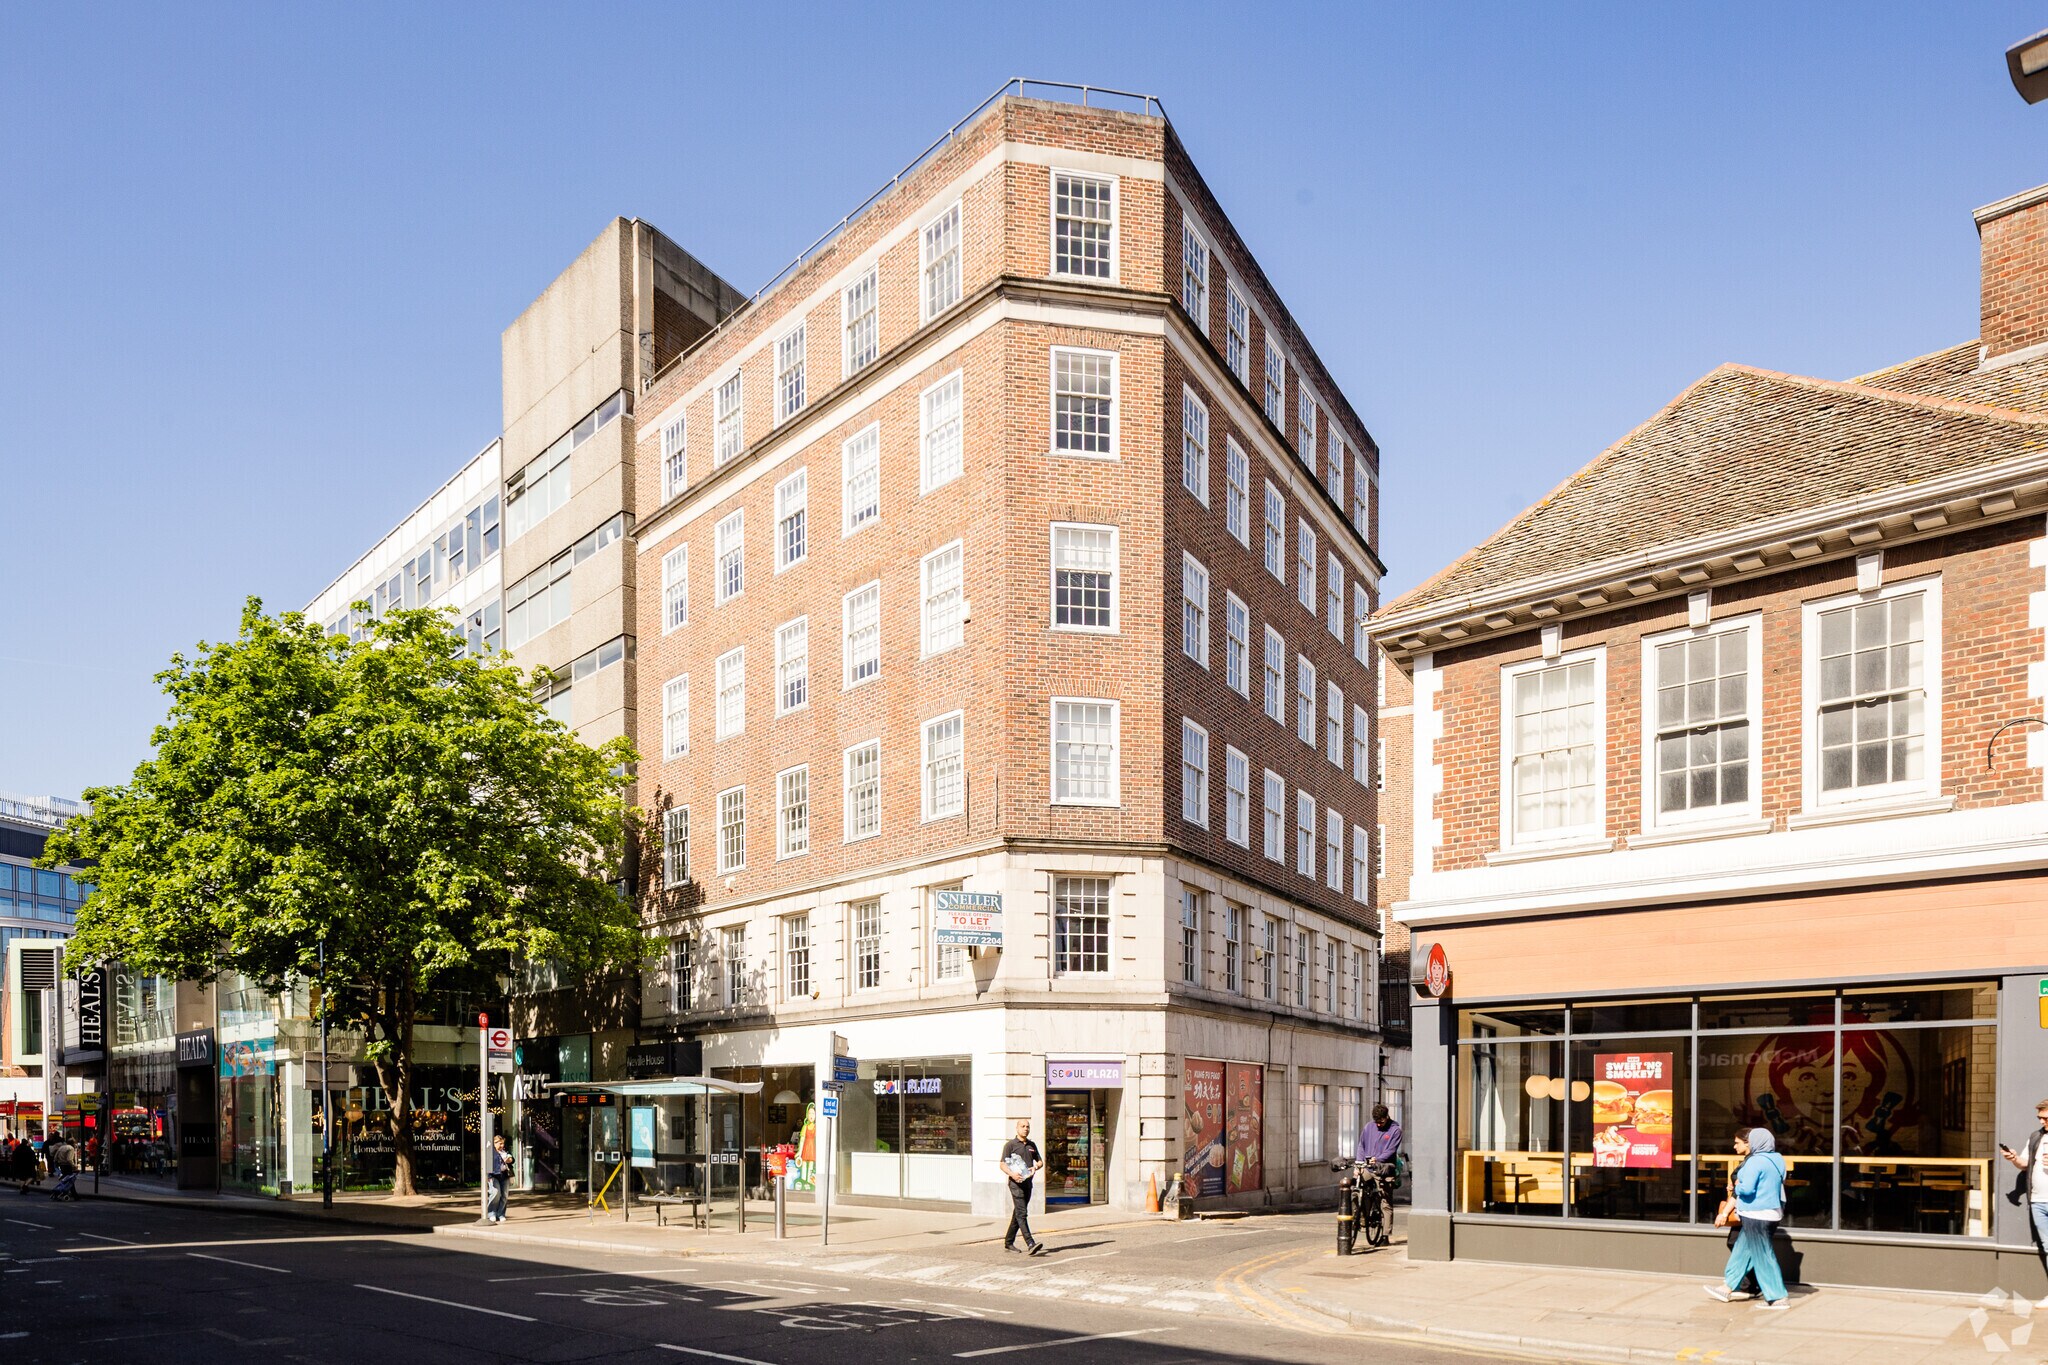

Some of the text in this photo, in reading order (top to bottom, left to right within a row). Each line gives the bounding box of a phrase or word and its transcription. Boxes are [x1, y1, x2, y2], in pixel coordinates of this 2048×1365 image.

[938, 893, 1001, 910] SNELLER
[949, 904, 998, 912] COMMERCIAL
[953, 917, 989, 925] TO LET
[938, 935, 955, 943] 020
[980, 937, 1001, 945] 2204
[81, 972, 101, 1044] HEAL'S
[179, 1034, 208, 1061] HEAL'S
[627, 1055, 664, 1067] Neville House
[1605, 1062, 1642, 1071] SWEET
[560, 1072, 589, 1082] FUSION
[1052, 1069, 1119, 1079] SEOUL PLAZA
[1194, 1070, 1220, 1080] KUNG FU FOOD
[1605, 1070, 1654, 1079] SMOKEY
[513, 1073, 550, 1100] ARTS
[874, 1080, 907, 1095] SEOU
[907, 1078, 941, 1094] PLAZA
[428, 1133, 446, 1141] 20%
[413, 1143, 461, 1151] rden furniture
[535, 1279, 850, 1306] CLEAR
[753, 1298, 1013, 1331] KEEP
